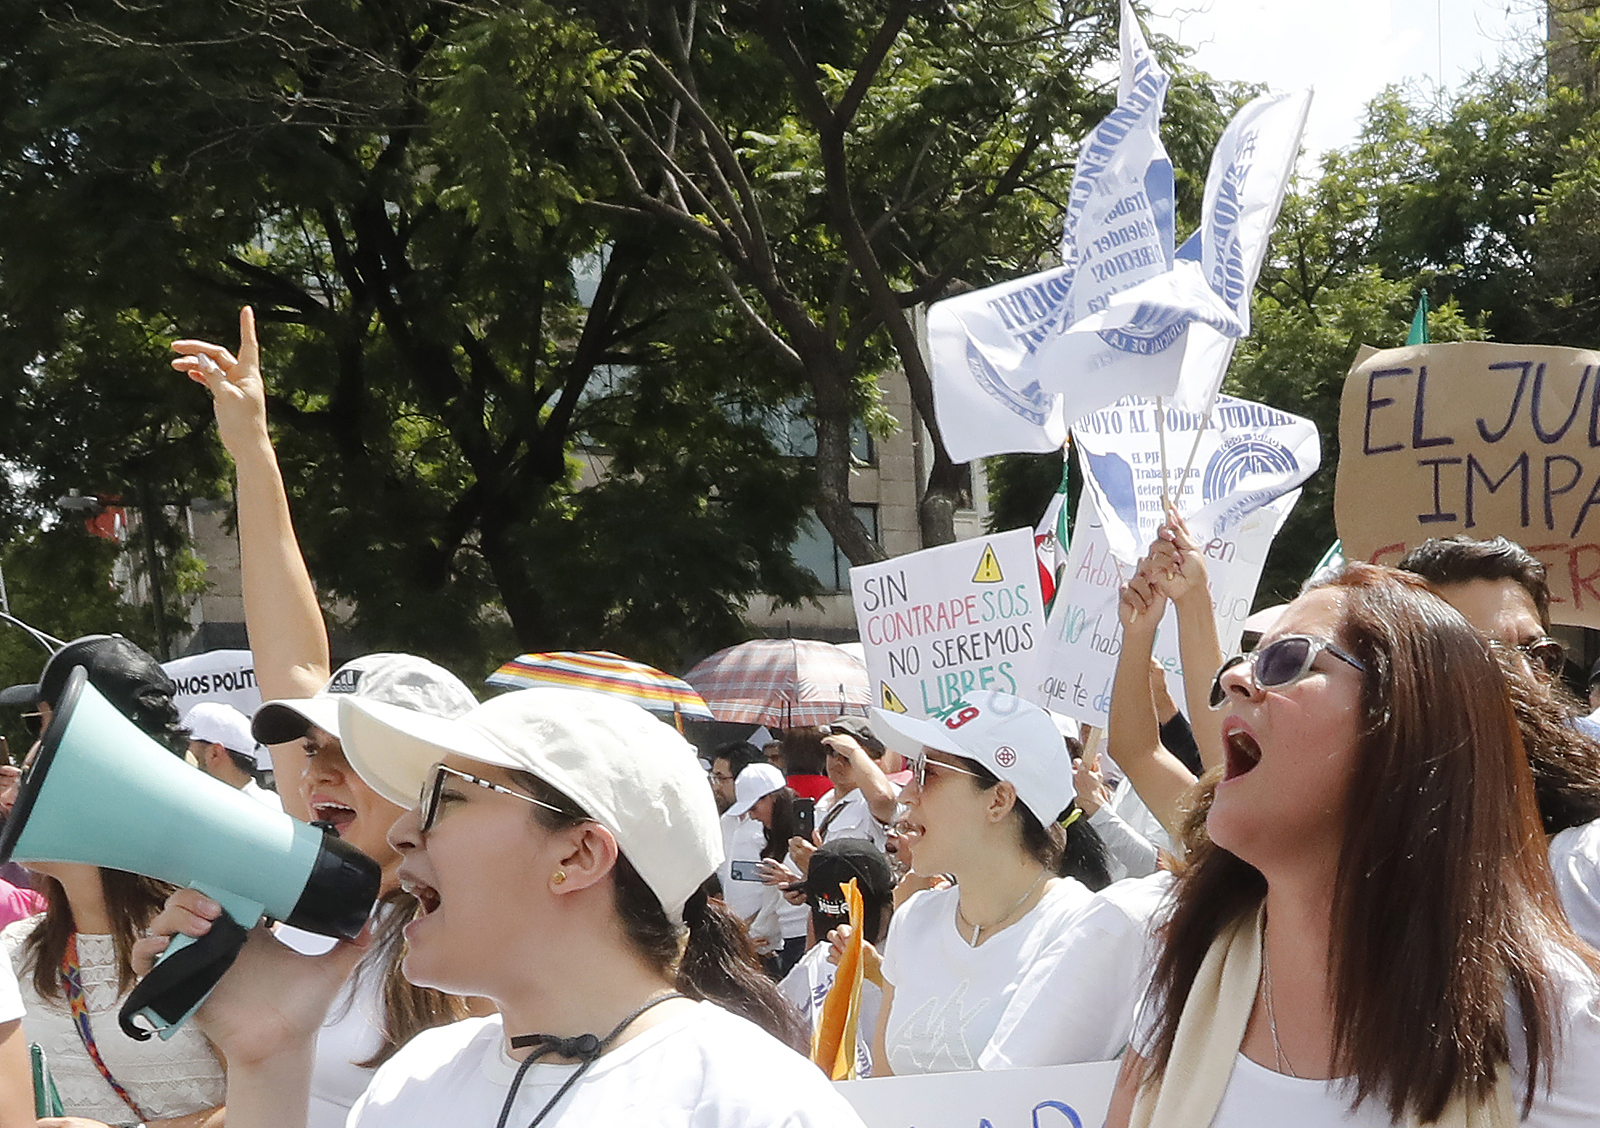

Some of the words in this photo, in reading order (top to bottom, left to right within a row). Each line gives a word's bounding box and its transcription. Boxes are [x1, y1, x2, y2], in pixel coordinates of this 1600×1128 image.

[1130, 409, 1150, 434] AL
[1363, 366, 1453, 455] EL
[862, 570, 909, 612] SIN
[1059, 604, 1085, 644] NO
[888, 645, 920, 679] NO
[932, 622, 1034, 669] SEREMOS
[920, 661, 1017, 715] LIBRES
[1043, 676, 1068, 708] que
[1073, 673, 1088, 707] te
[1092, 677, 1113, 713] de
